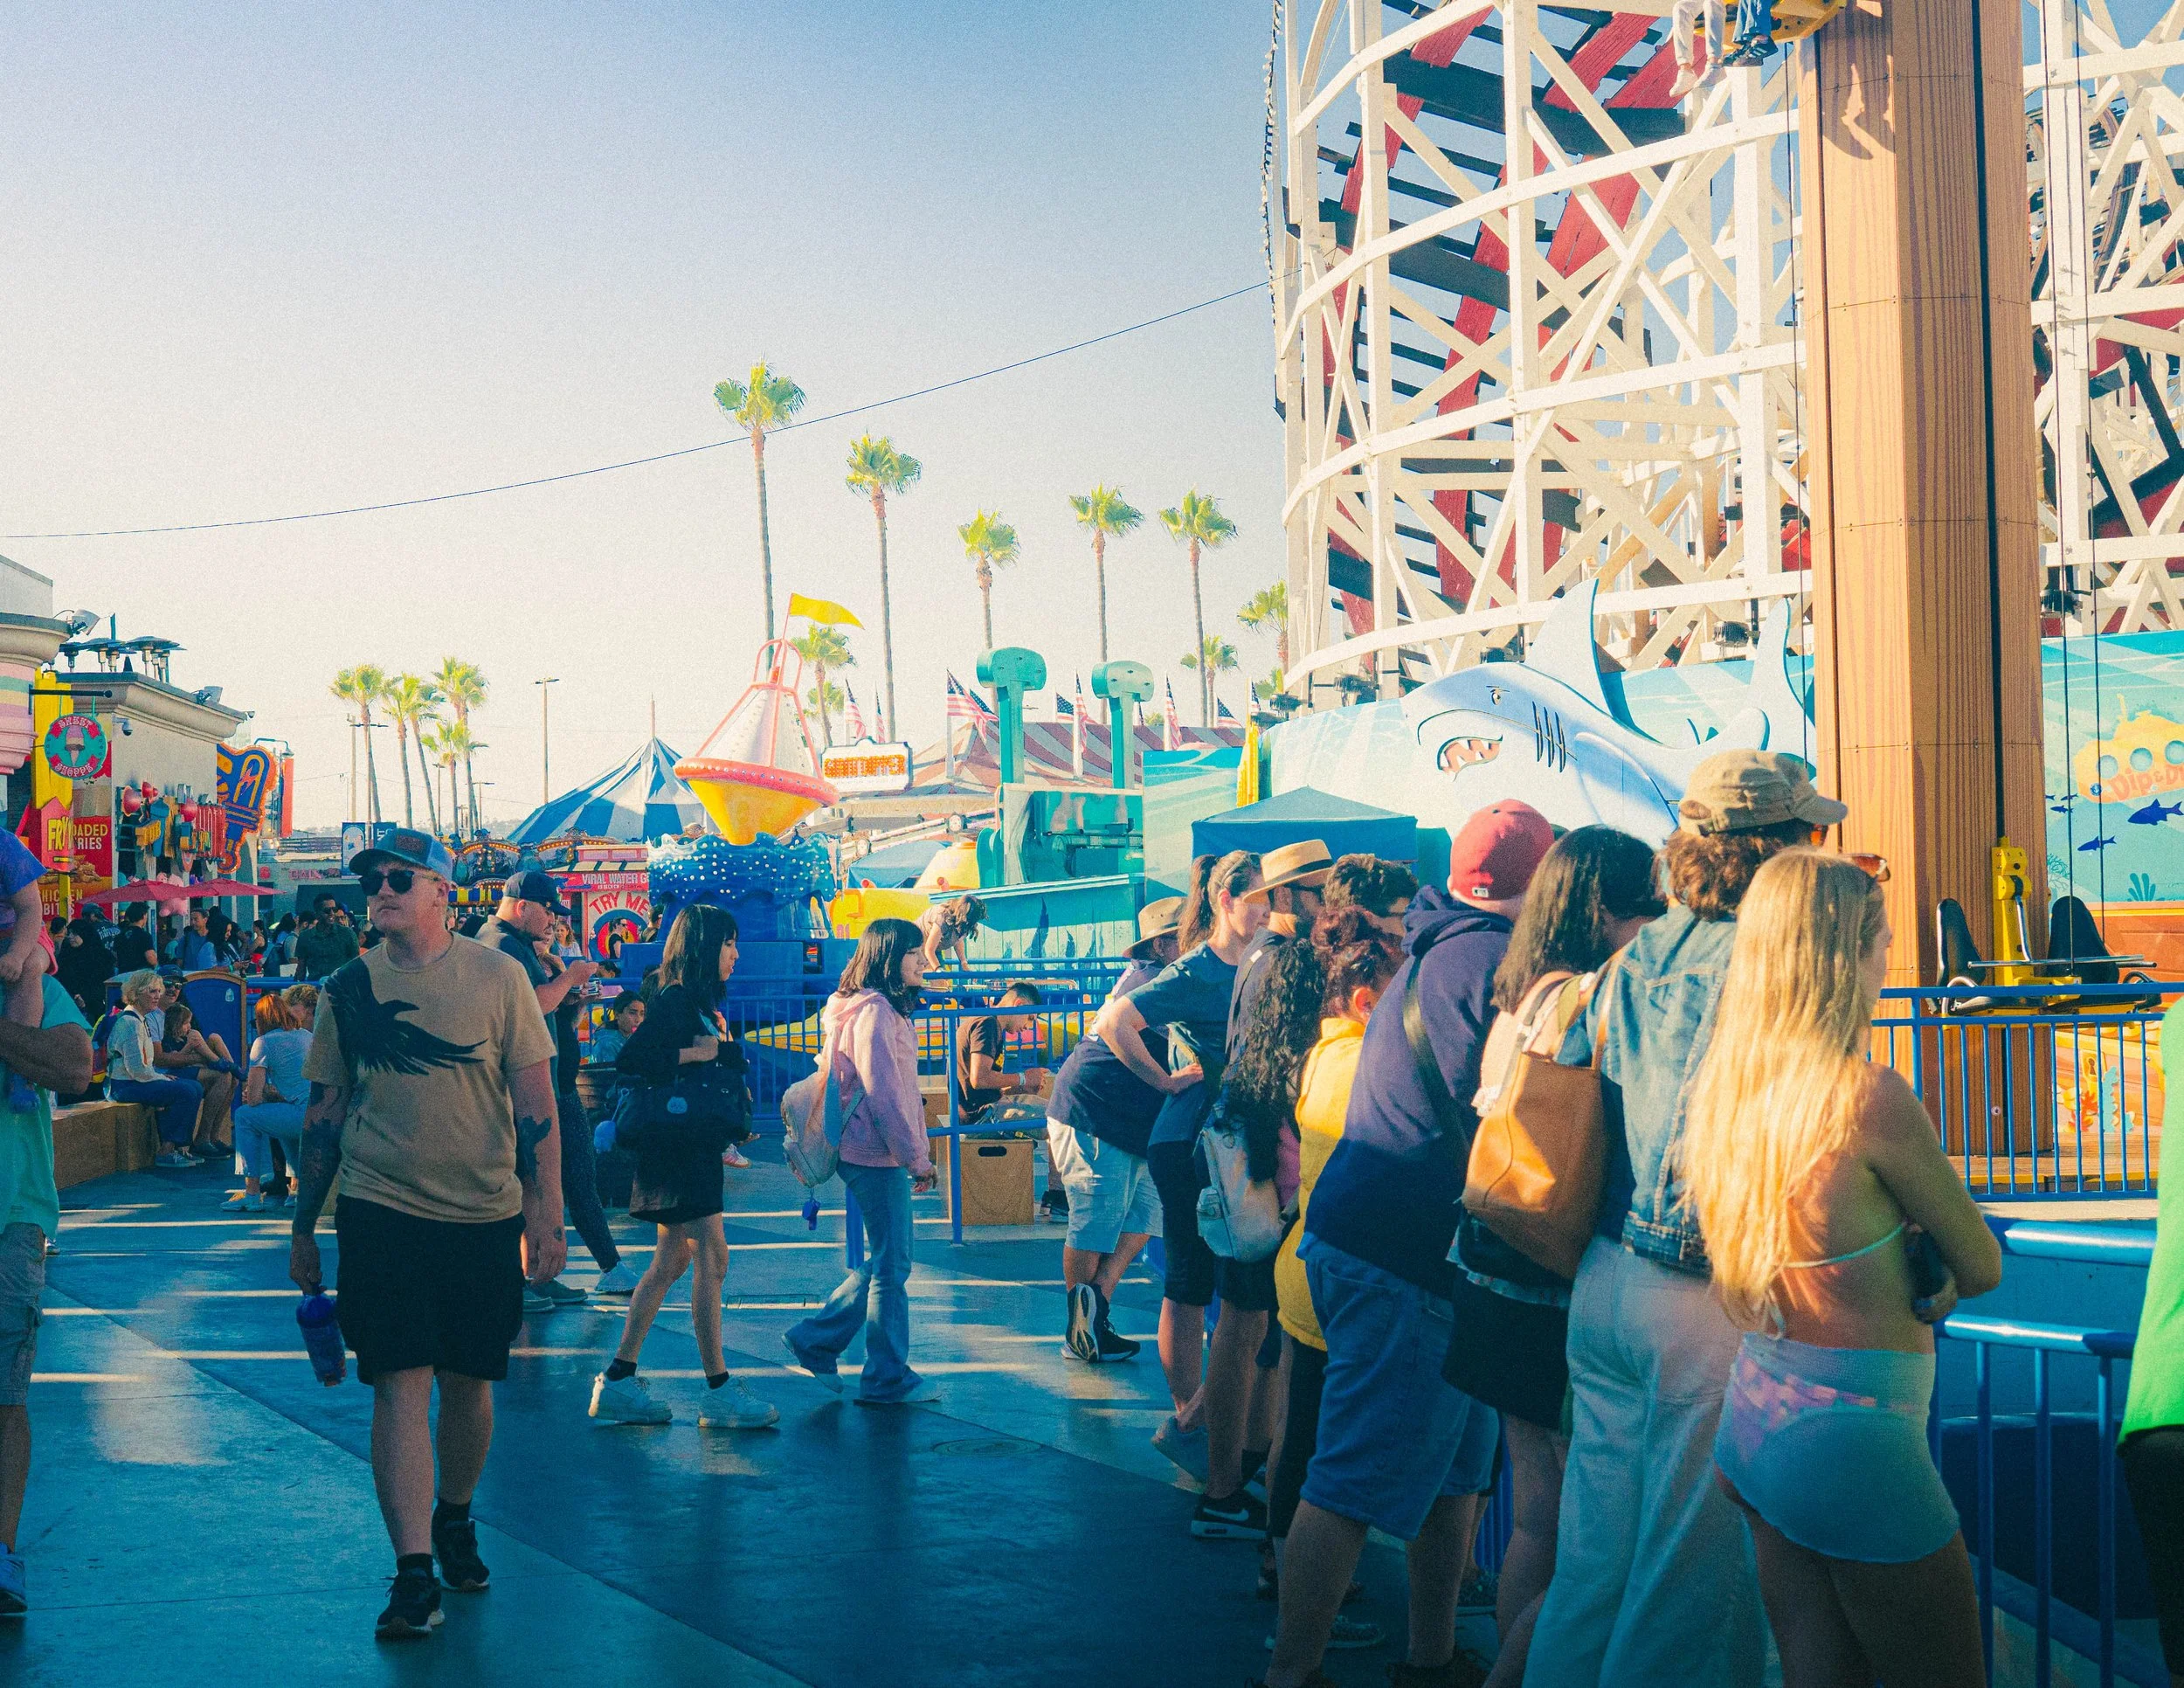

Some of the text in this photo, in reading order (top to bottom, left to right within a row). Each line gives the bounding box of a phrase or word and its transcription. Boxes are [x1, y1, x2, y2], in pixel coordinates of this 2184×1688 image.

[2109, 768, 2153, 801] Dip
[582, 874, 606, 884] VIRAL
[609, 874, 638, 884] WATER
[589, 891, 650, 916] TRY ME
